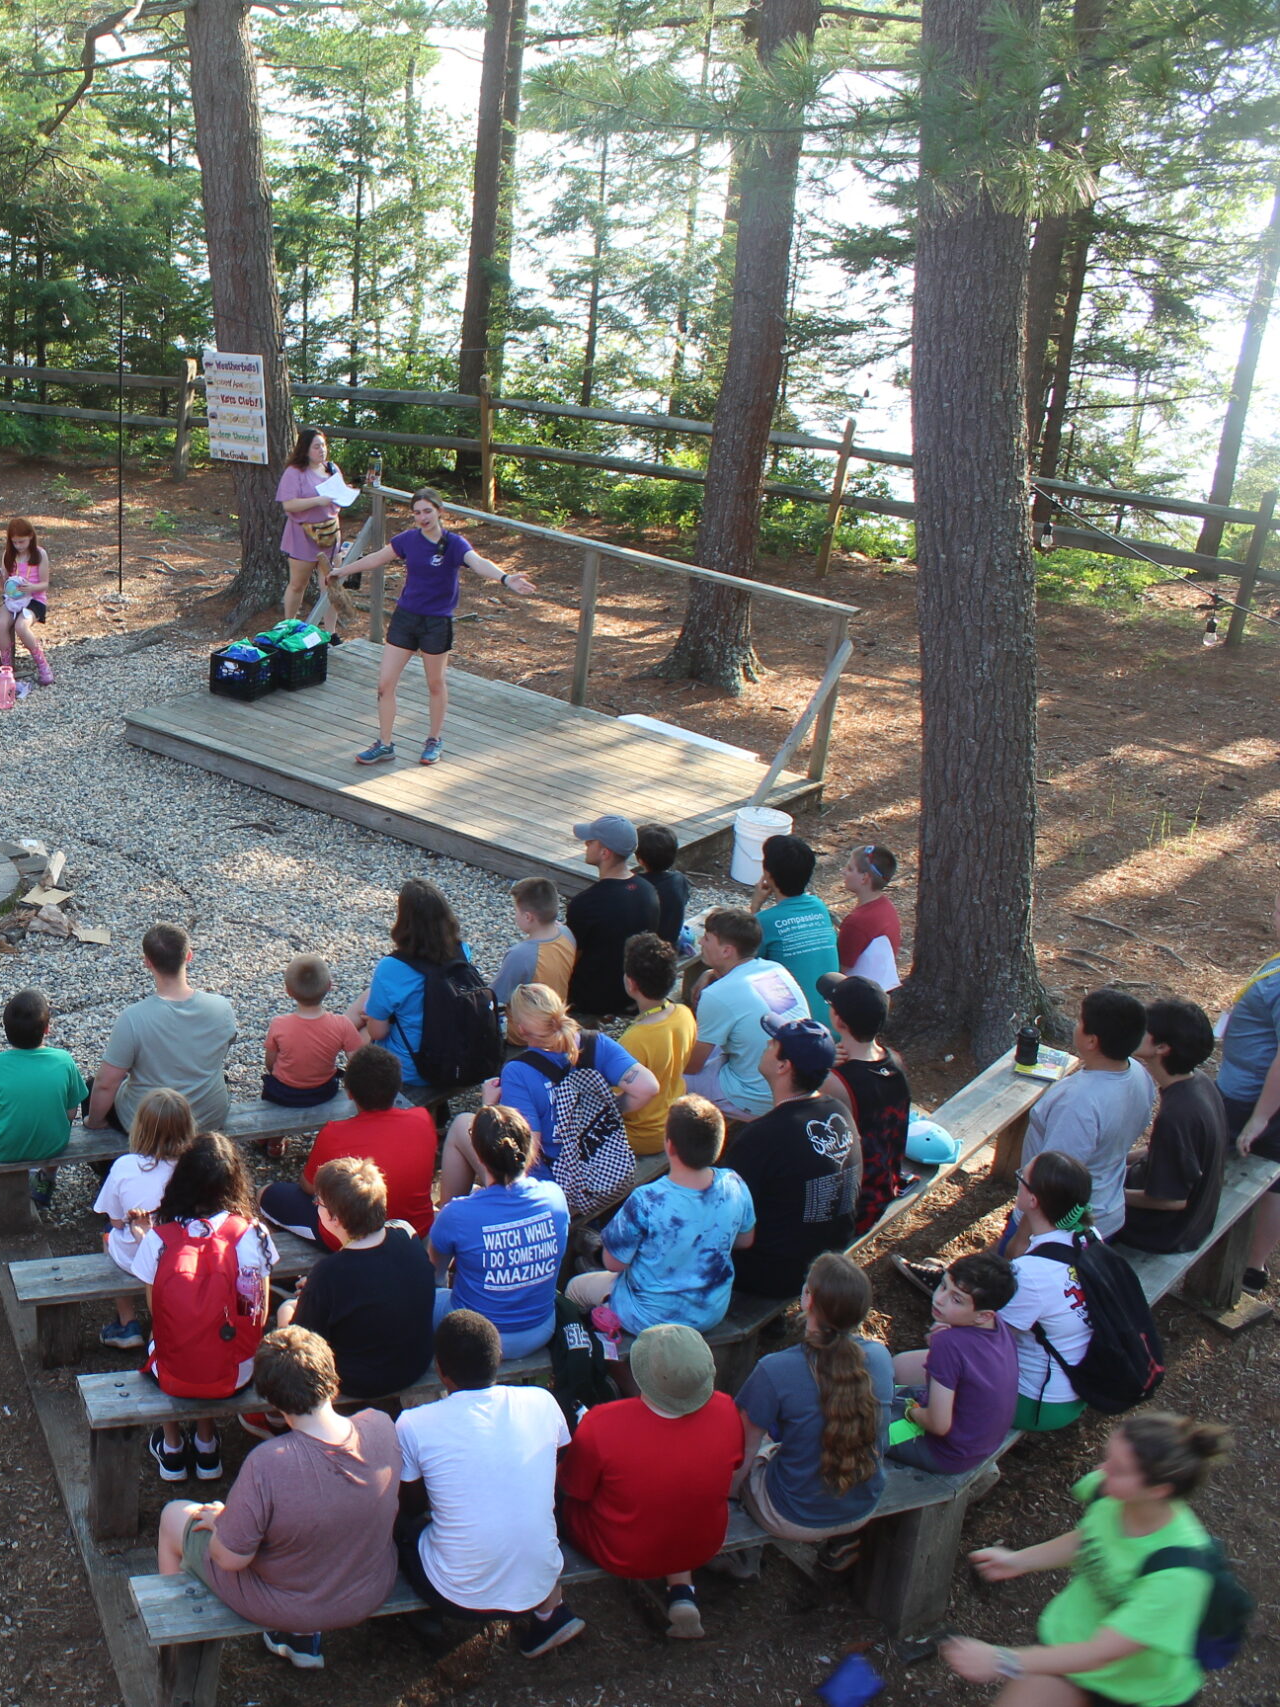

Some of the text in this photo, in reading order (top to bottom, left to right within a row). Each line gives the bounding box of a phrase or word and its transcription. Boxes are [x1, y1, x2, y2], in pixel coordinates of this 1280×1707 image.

[774, 913, 824, 929] Compassion
[483, 1219, 556, 1251] WATCH WHILE
[482, 1239, 558, 1268] I DO SOMETHING
[484, 1258, 556, 1284] AMAZING
